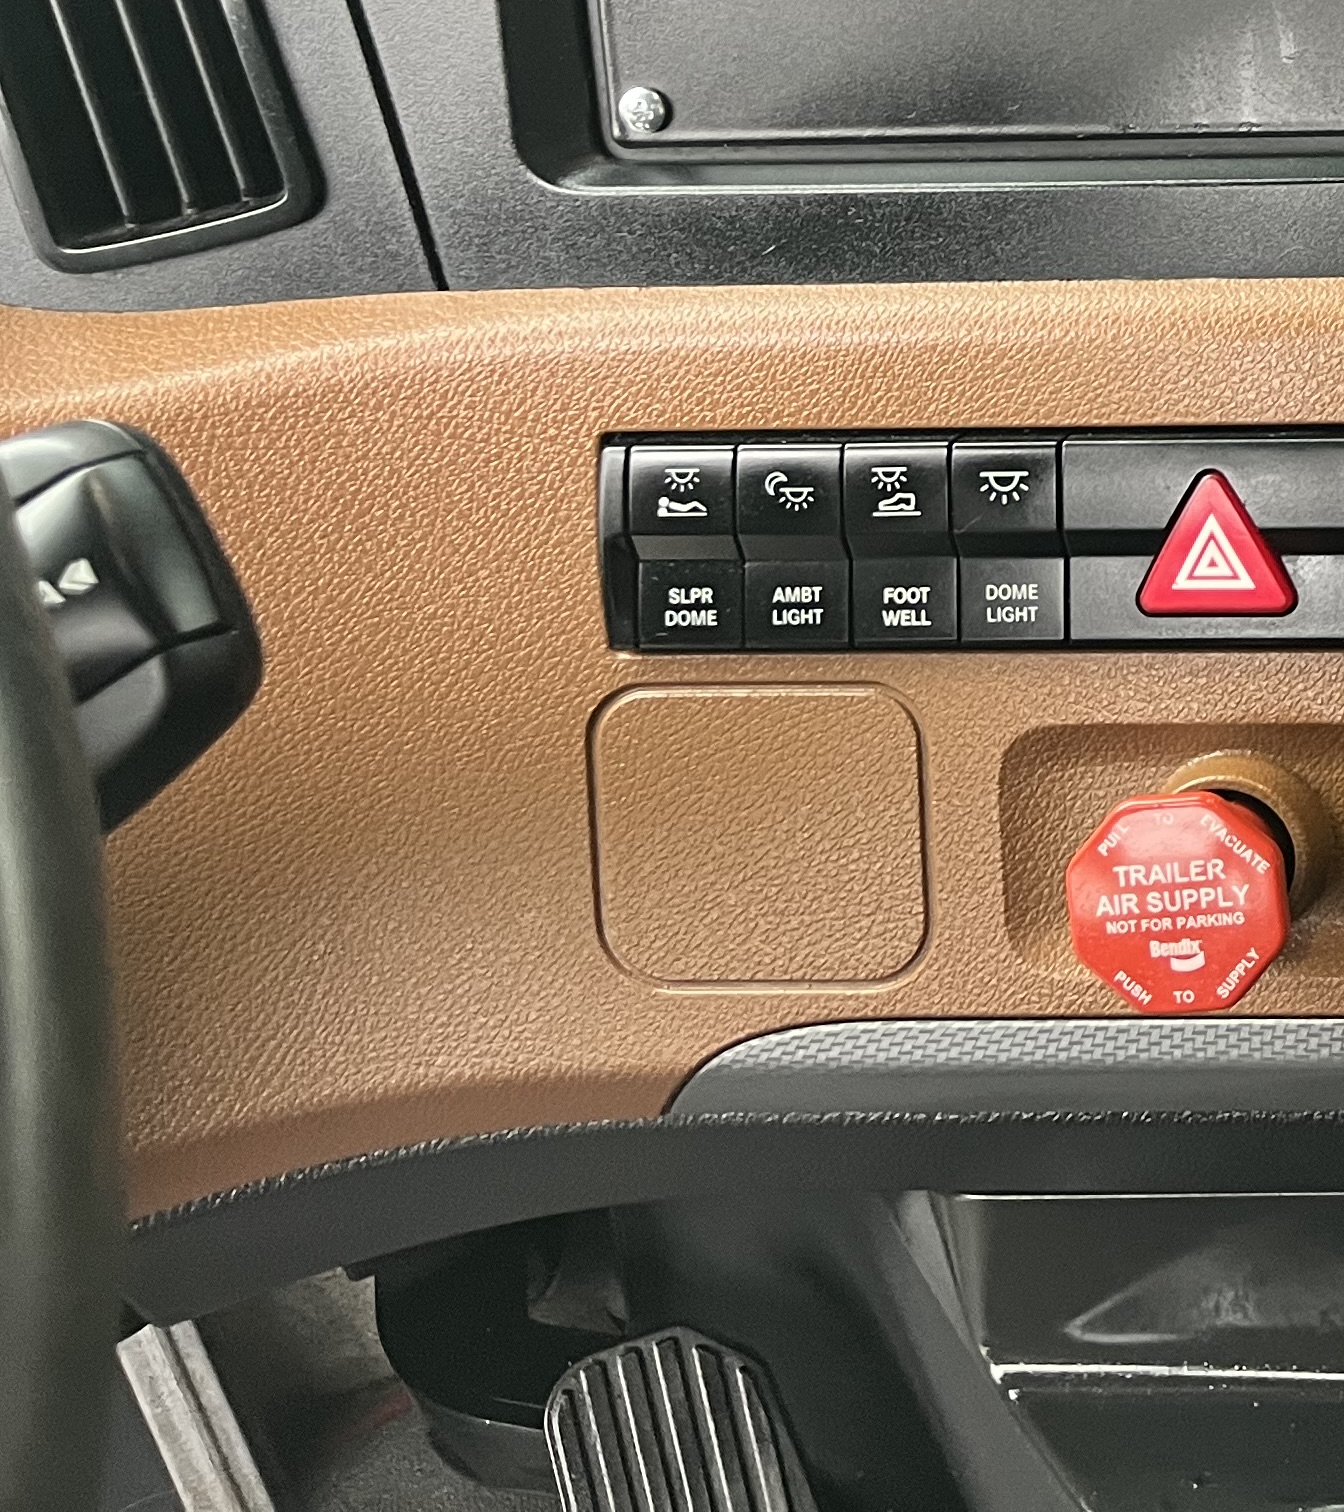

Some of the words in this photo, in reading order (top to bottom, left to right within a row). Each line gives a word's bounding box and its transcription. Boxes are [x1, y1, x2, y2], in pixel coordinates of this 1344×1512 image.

[668, 587, 715, 606] SLPR
[772, 586, 823, 604] AMBT
[882, 586, 932, 605] FOOT
[985, 583, 1040, 602] DOME
[663, 609, 719, 628] DOME
[771, 607, 825, 627] LIGHT
[881, 608, 932, 628] WELL
[986, 605, 1039, 624] LIGHT
[1153, 811, 1175, 826] TO
[1199, 813, 1272, 876] EVACUATE
[1112, 859, 1226, 887] TRAILER
[1096, 892, 1142, 918] AIR
[1146, 883, 1250, 913] SUPPLY
[1106, 919, 1138, 935] NOT
[1141, 916, 1173, 932] FOR
[1176, 910, 1247, 930] PARKING
[1149, 938, 1202, 958] Bendix
[1114, 970, 1153, 1006] PUSH
[1173, 990, 1196, 1004] TO
[1216, 946, 1260, 1000] SUPPLY
